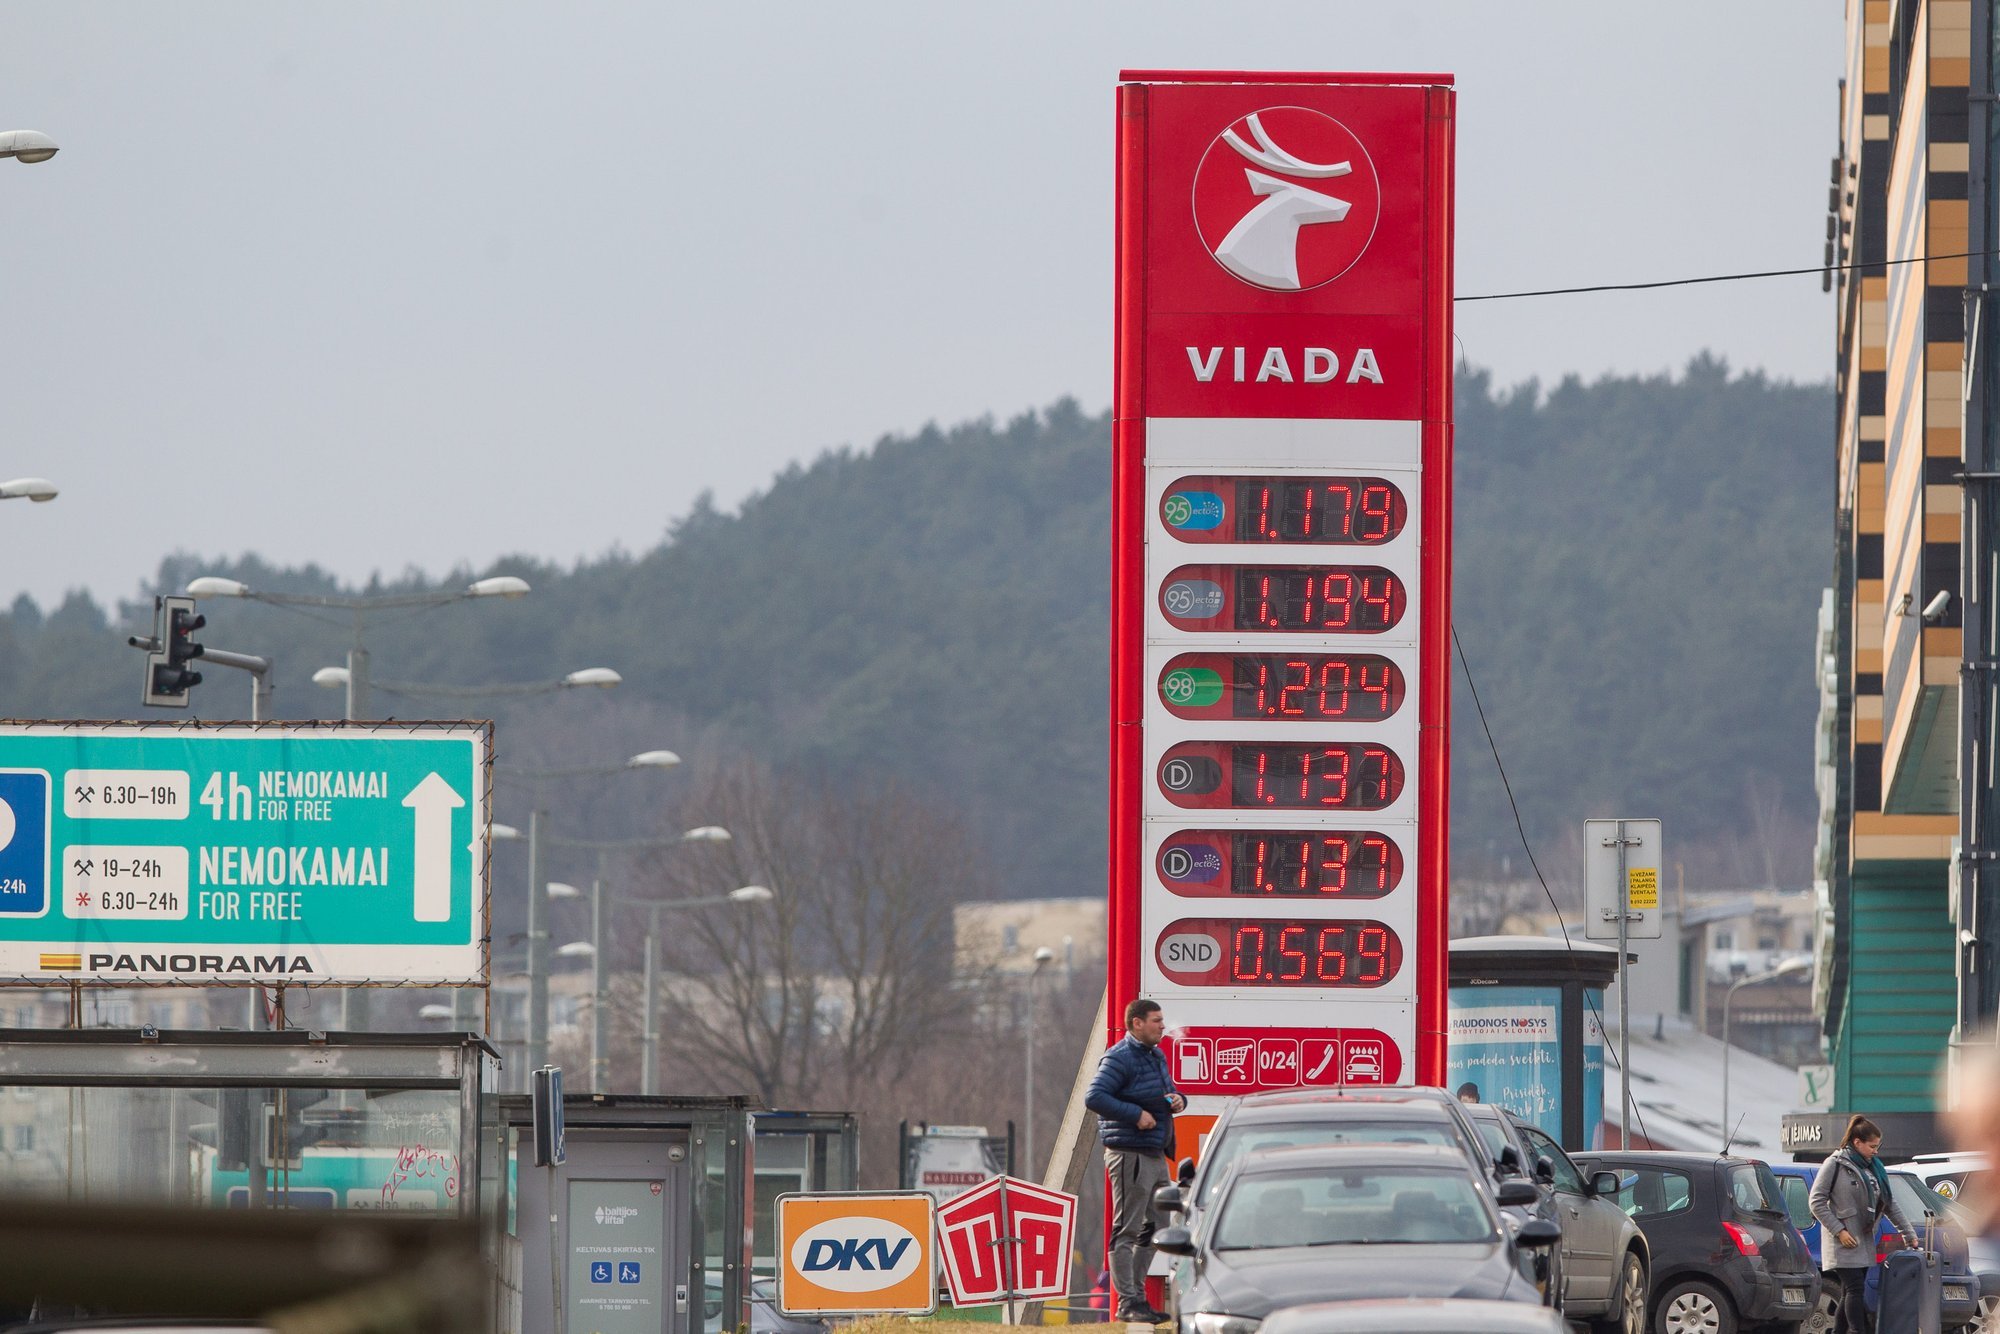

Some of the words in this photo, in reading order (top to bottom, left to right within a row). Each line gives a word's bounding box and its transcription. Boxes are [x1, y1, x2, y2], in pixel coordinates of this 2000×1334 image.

[1186, 347, 1384, 384] VIADA
[1164, 501, 1188, 521] 95
[1193, 507, 1211, 515] ecto
[1259, 486, 1391, 539] 1.179
[1167, 590, 1191, 609] 95
[1195, 597, 1213, 605] ecto
[1259, 574, 1392, 627] 1.194
[1167, 677, 1192, 697] 98
[1258, 662, 1389, 715] 1.204
[259, 770, 388, 799] NEMOKAMAI
[1170, 765, 1187, 786] D
[1257, 750, 1388, 803] 1.137
[200, 771, 252, 821] 4h
[259, 801, 288, 821] FOR
[294, 801, 332, 821] FREE
[199, 846, 388, 886] NEMOKAMAI
[1170, 853, 1187, 874] D
[1194, 860, 1212, 868] ecto
[1255, 838, 1388, 892] 1.137
[199, 892, 239, 920] FOR
[249, 892, 302, 920] FREE
[1168, 942, 1213, 962] SND
[1233, 927, 1388, 981] 0.569
[89, 954, 314, 974] PANORAMA
[1453, 1018, 1508, 1029] RAUDONOS
[1511, 1017, 1548, 1028] NOSYS
[1260, 1051, 1297, 1070] 0/24
[604, 1206, 638, 1218] baltijos
[604, 1215, 624, 1225] liftai
[802, 1237, 913, 1272] DKV
